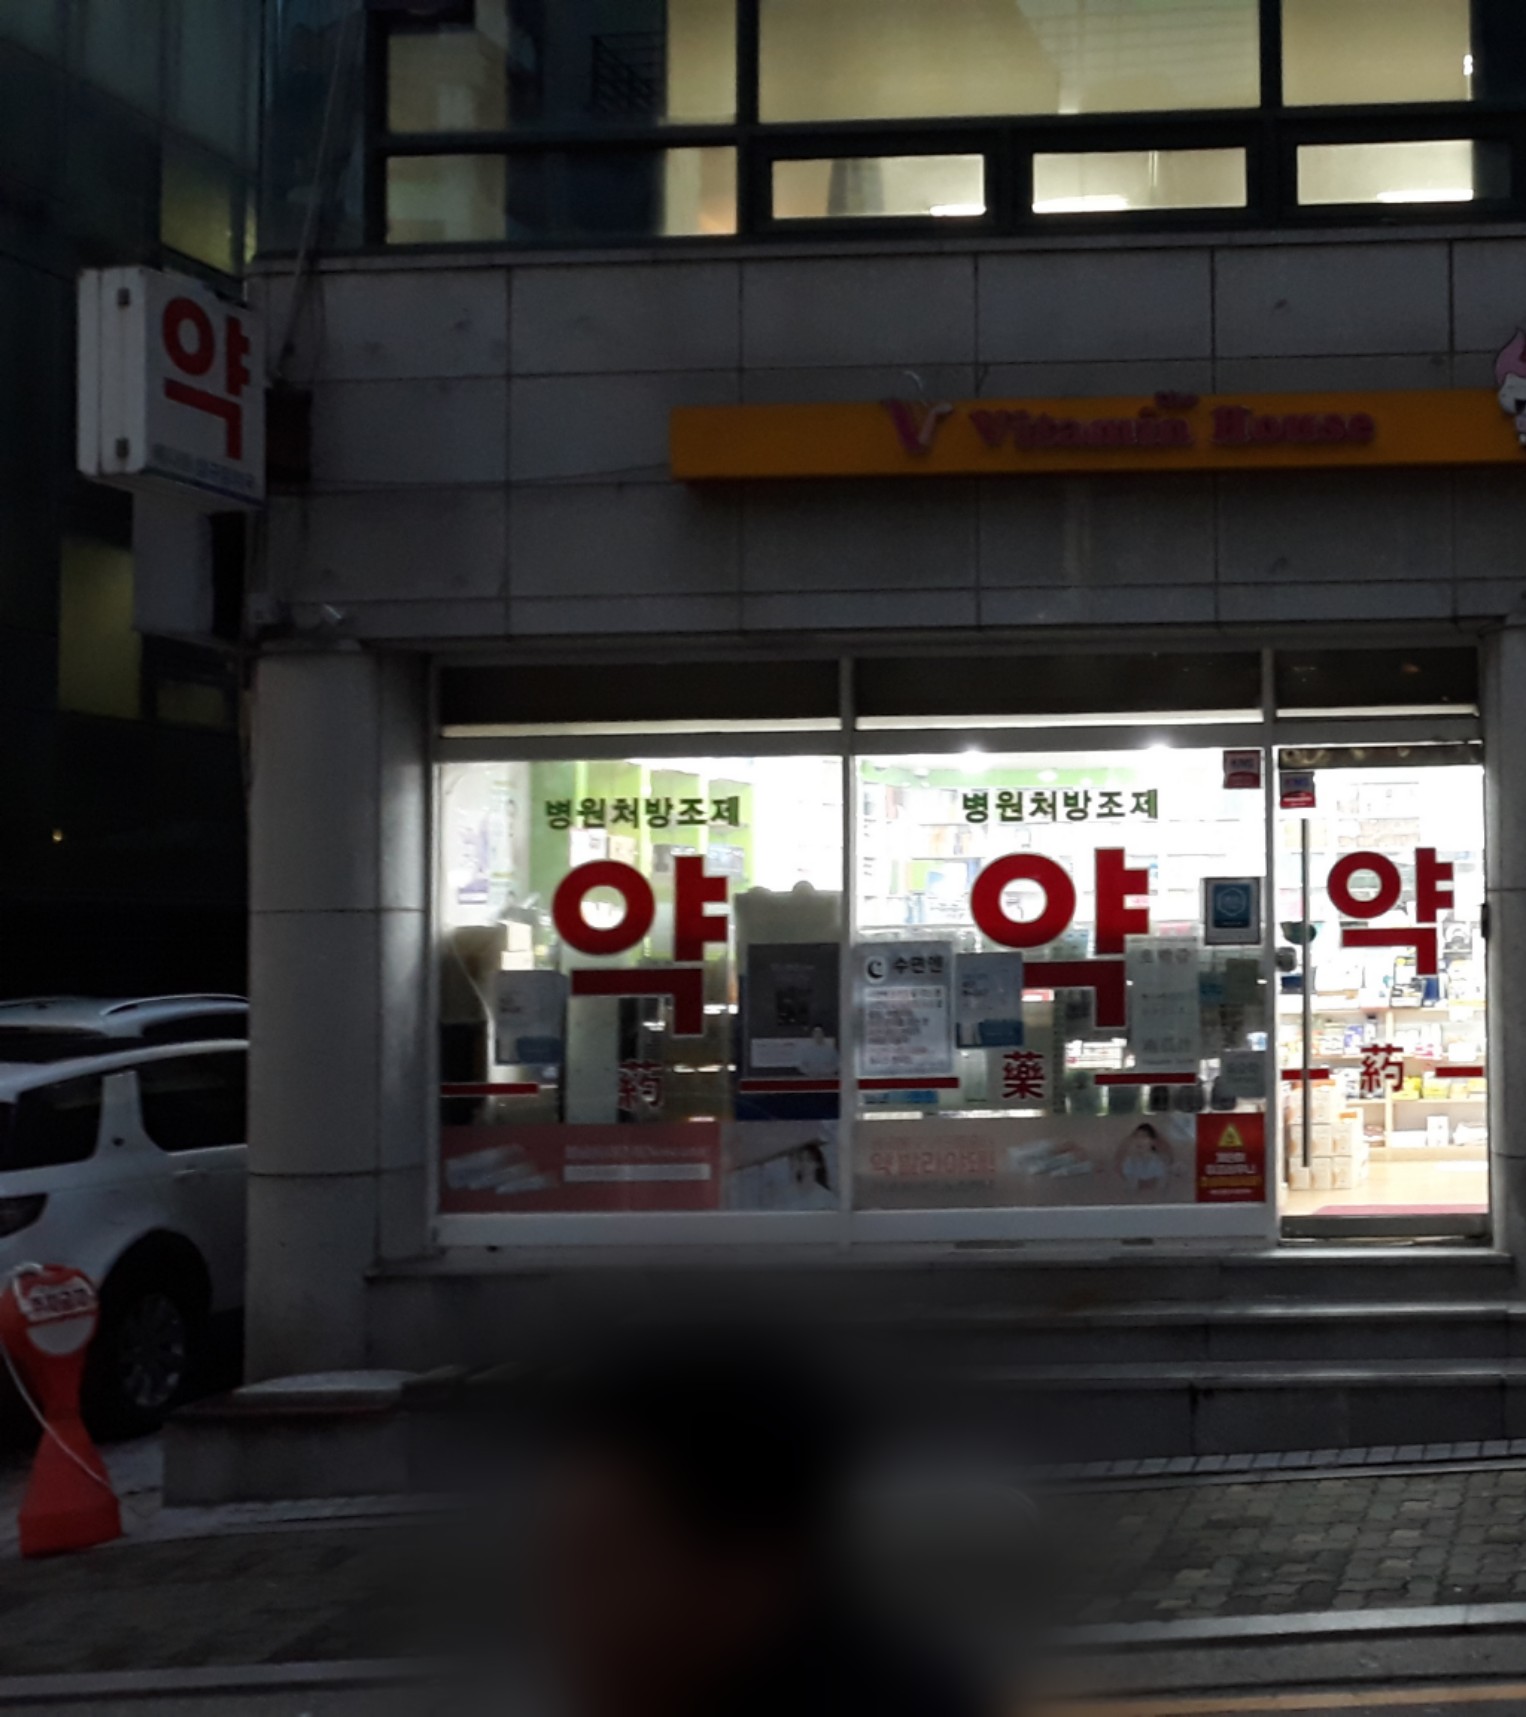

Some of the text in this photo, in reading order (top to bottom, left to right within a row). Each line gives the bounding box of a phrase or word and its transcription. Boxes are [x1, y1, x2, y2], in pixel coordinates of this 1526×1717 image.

[163, 297, 251, 460] 약
[969, 407, 1193, 450] Vitamin
[1211, 405, 1376, 445] House
[544, 796, 742, 830] 병원처방조제
[962, 788, 1160, 823] 병원처방조제
[552, 856, 729, 1035] 약
[971, 847, 1150, 1028] 약
[1327, 847, 1454, 975] 약
